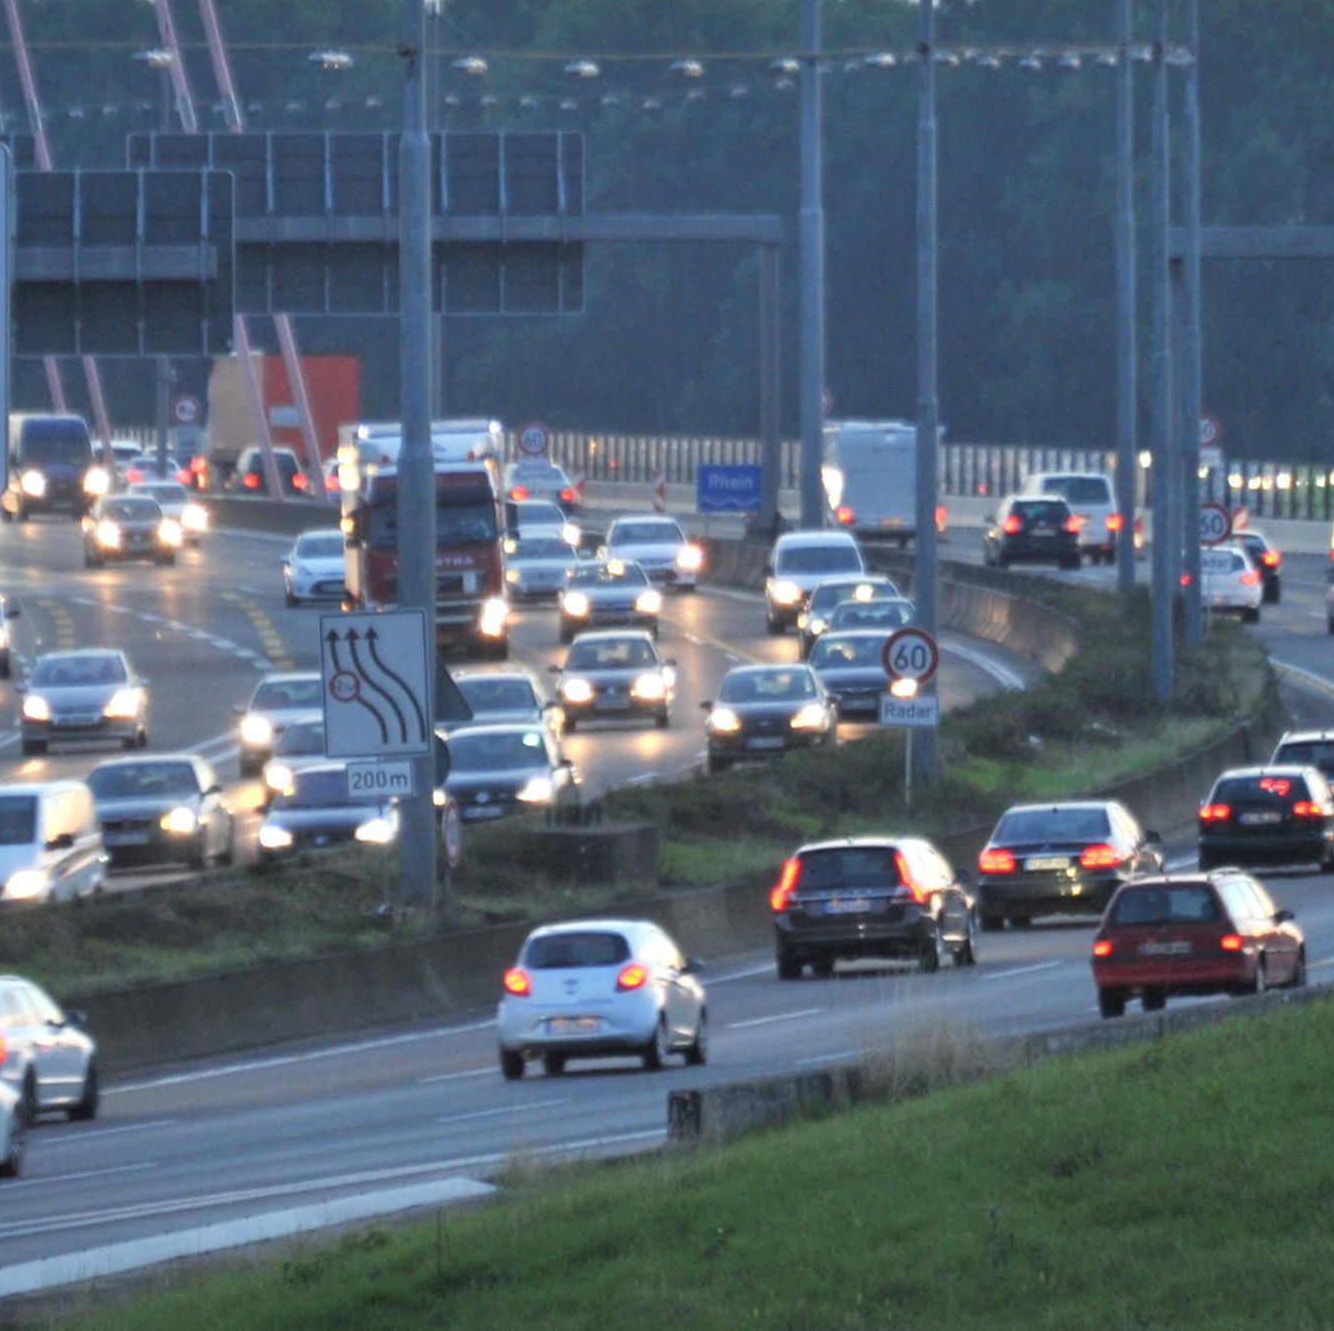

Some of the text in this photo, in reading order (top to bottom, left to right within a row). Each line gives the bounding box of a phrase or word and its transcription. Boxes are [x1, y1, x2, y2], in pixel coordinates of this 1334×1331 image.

[709, 473, 754, 490] Rhein
[893, 643, 927, 671] 60
[884, 702, 934, 719] Radar
[352, 770, 408, 790] 200 m
